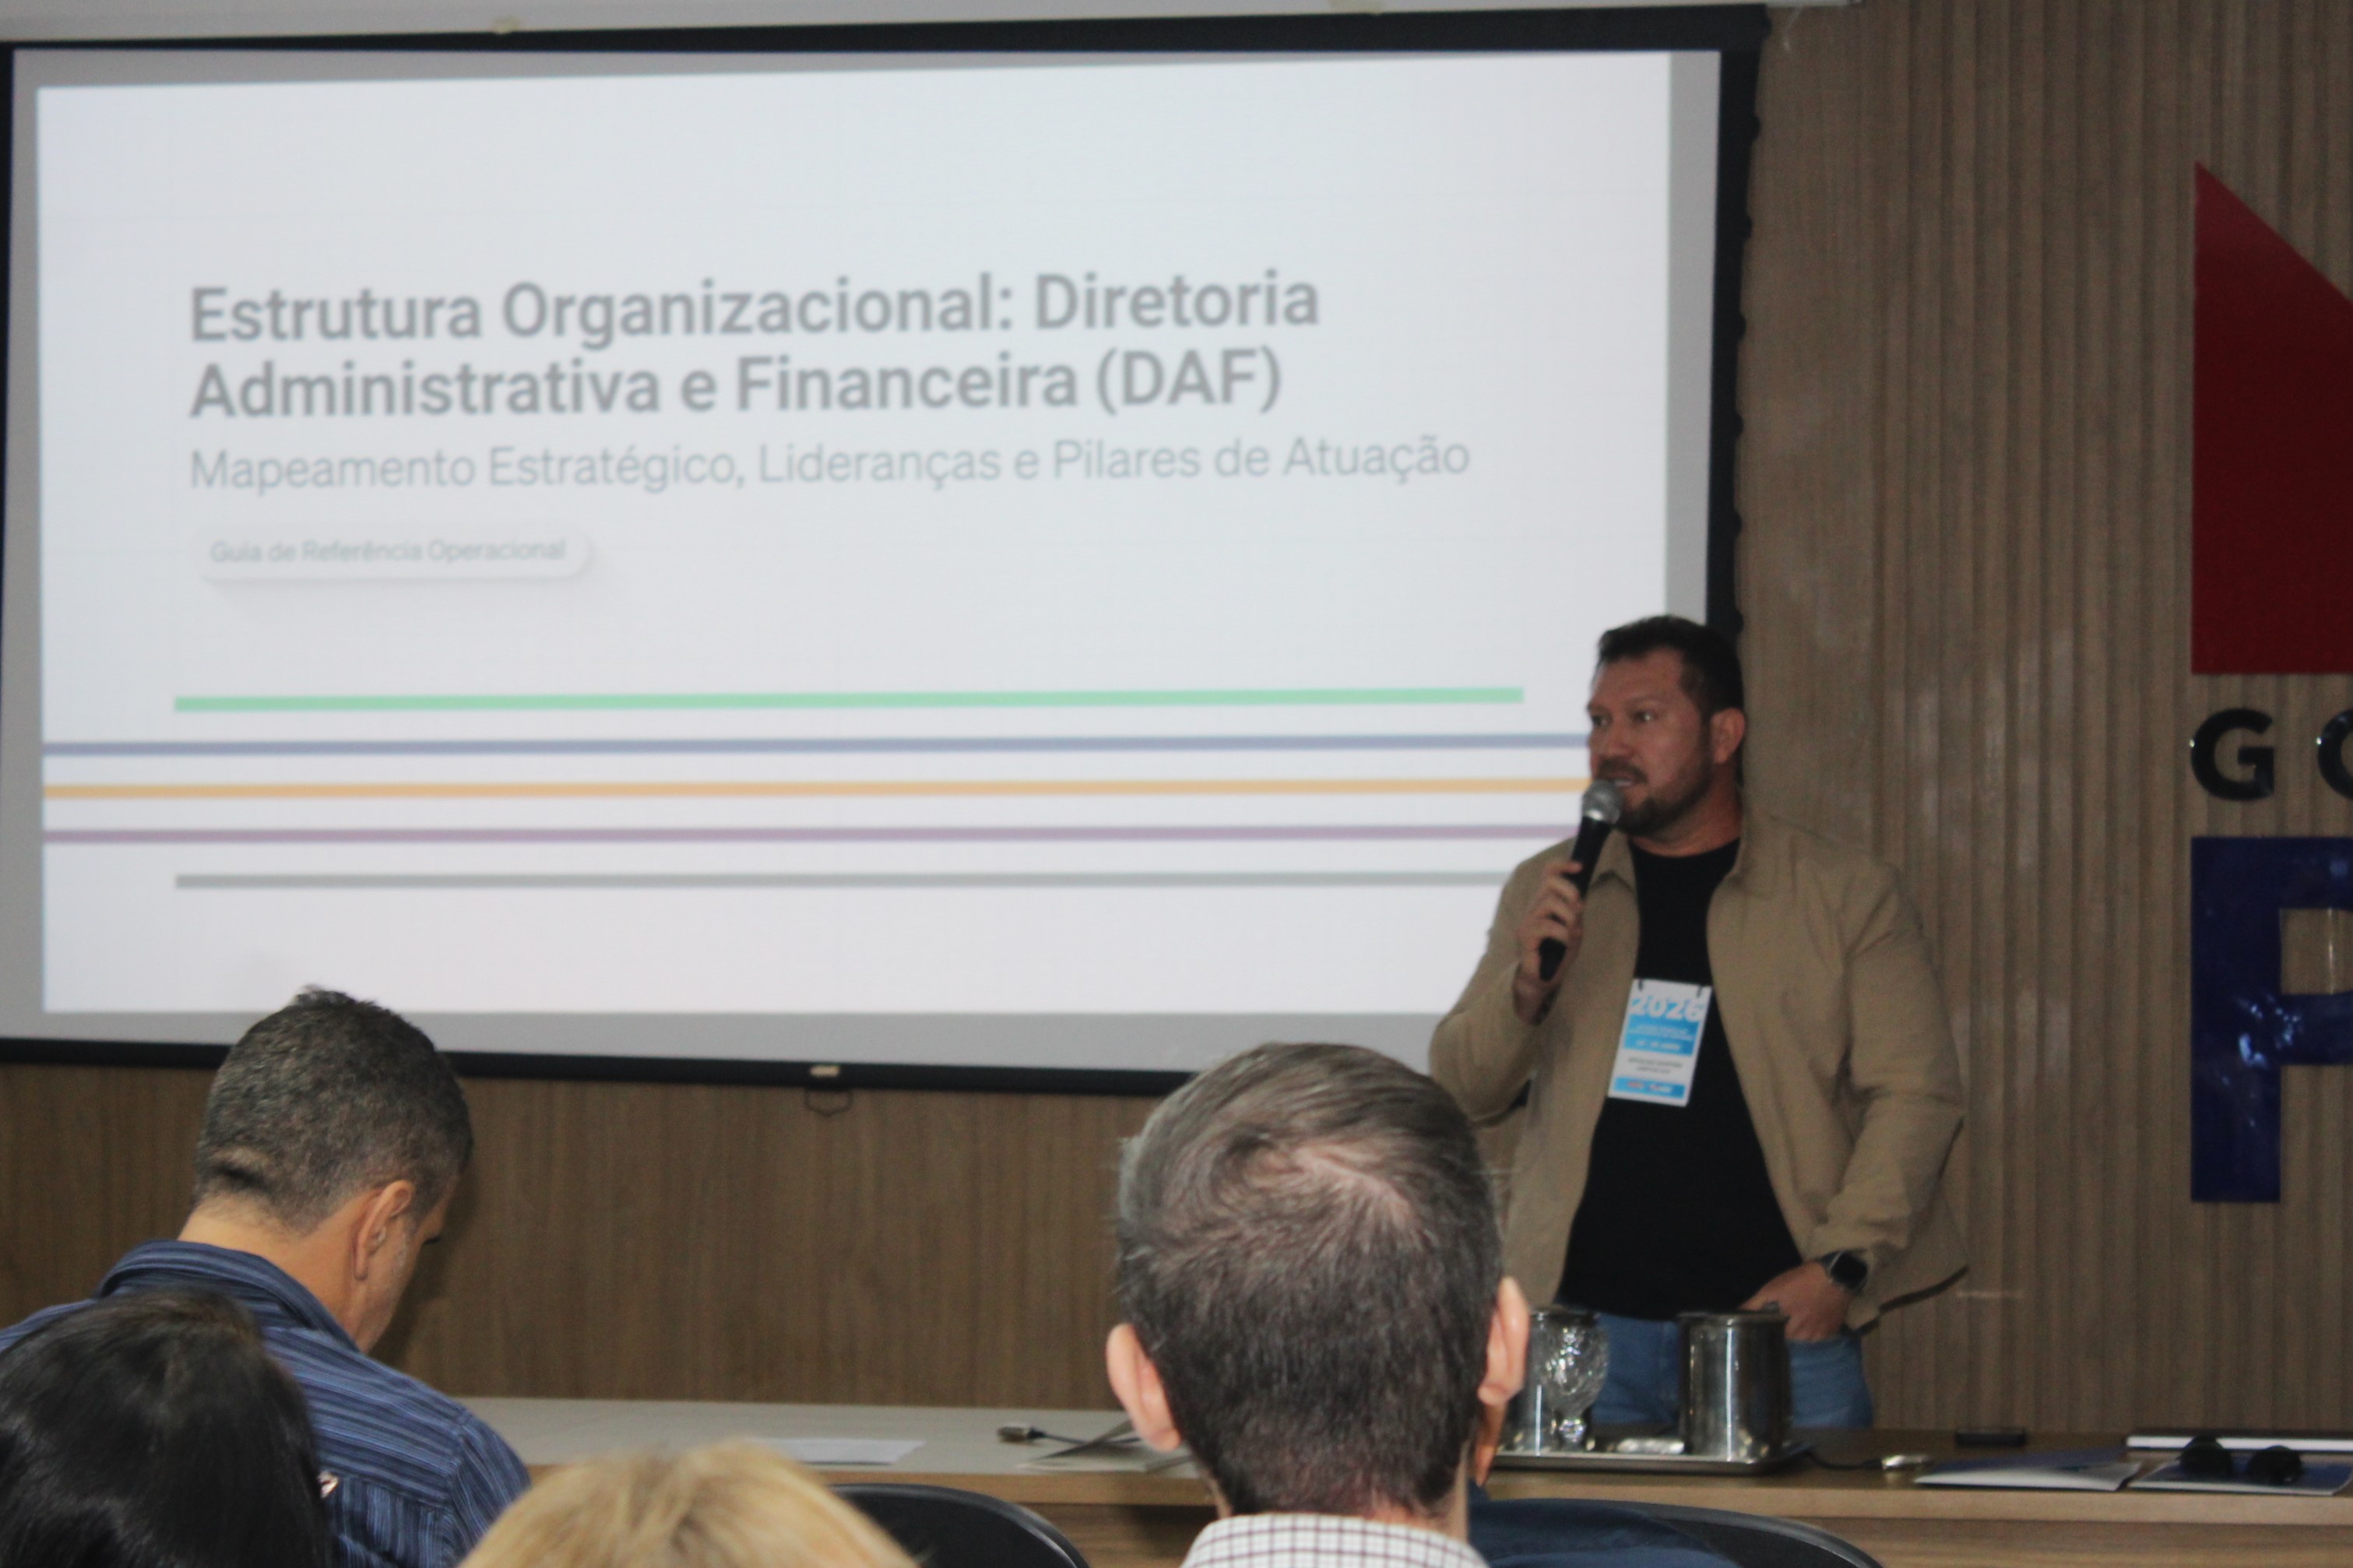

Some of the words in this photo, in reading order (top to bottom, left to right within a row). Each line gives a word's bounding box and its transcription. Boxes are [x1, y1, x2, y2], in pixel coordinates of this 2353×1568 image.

[192, 286, 482, 341] Estrutura
[502, 272, 1013, 350] Organizacional:
[1036, 269, 1319, 329] Diretoria
[189, 359, 659, 418] Administrativa
[680, 370, 717, 412] e
[737, 352, 1077, 411] Financeira
[1096, 346, 1280, 416] (DAF)
[192, 449, 476, 495] Mapeamento
[490, 445, 745, 493] Estratégico,
[759, 444, 1001, 490] Lideranças
[1014, 449, 1040, 480] e
[1054, 438, 1201, 478] Pilares
[1214, 437, 1271, 477] de
[1283, 434, 1470, 484] Atuação
[209, 539, 262, 563] Guia
[268, 539, 297, 562] de
[302, 537, 423, 562] Referência
[428, 536, 567, 564] Operacional
[1630, 996, 1704, 1023] 2026
